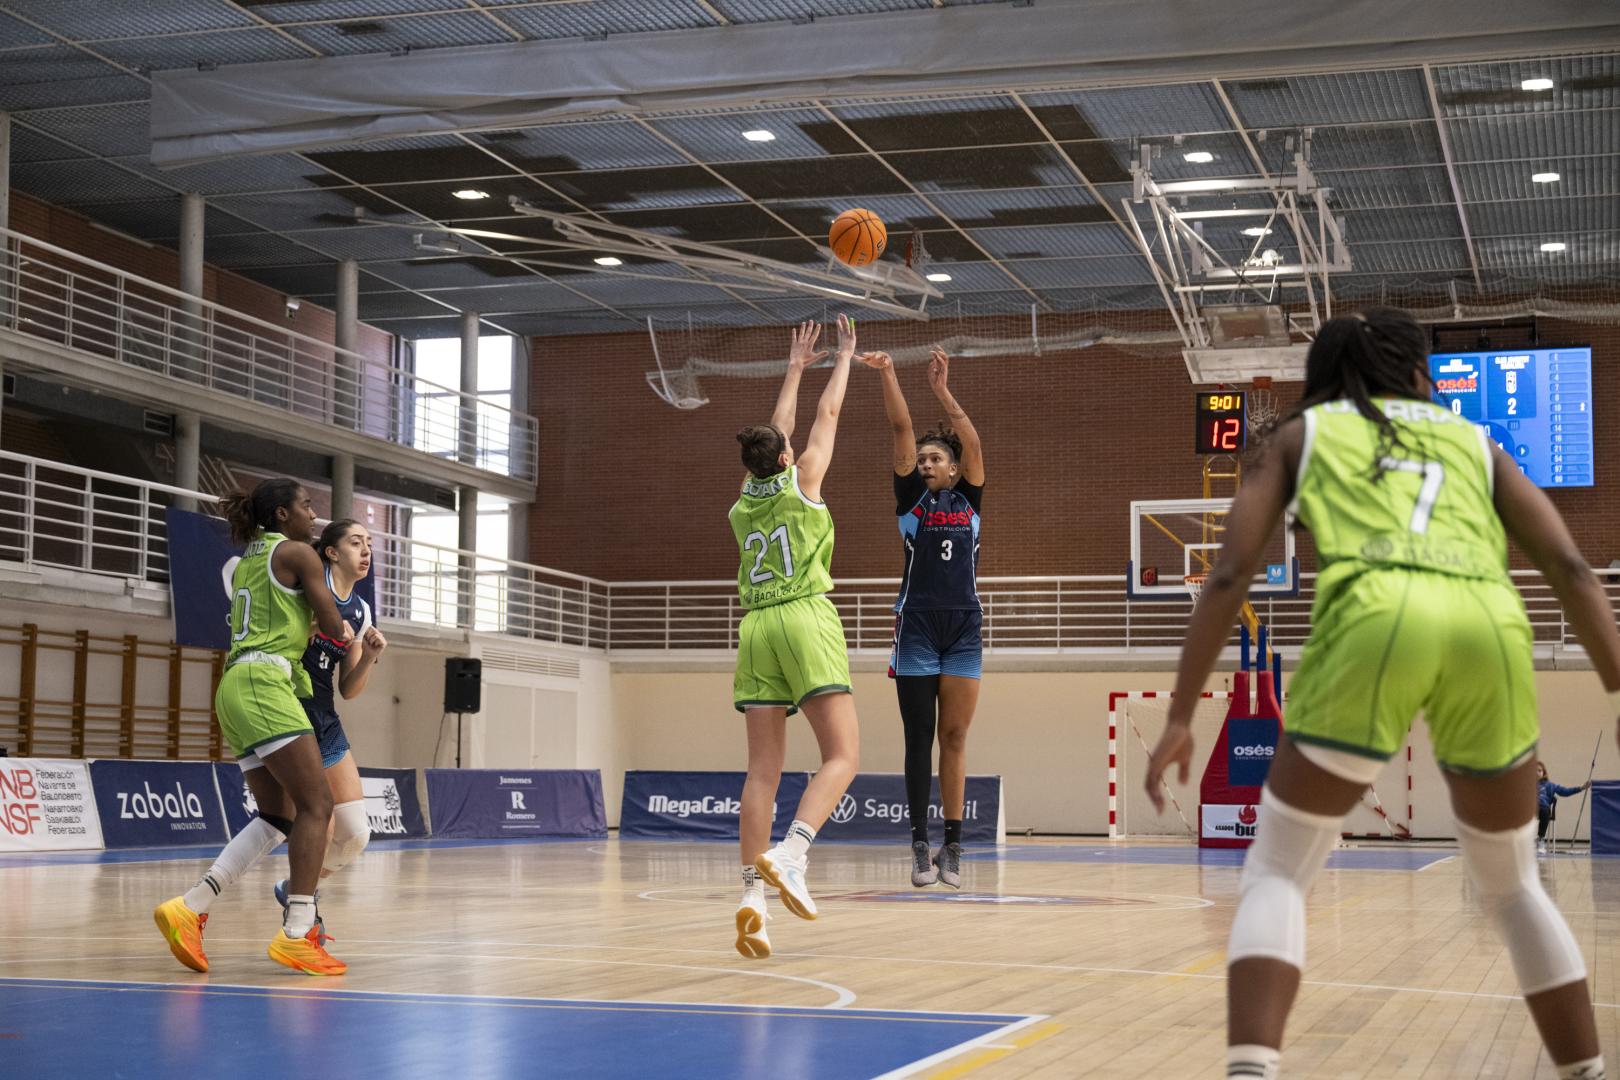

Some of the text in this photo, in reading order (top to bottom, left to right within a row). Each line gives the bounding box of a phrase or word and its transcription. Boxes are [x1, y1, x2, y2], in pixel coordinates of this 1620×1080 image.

[1210, 395, 1240, 410] 9:01
[1452, 398, 1461, 415] 0
[1507, 397, 1517, 415] 2
[1212, 418, 1240, 449] 12
[1378, 455, 1445, 535] 7
[744, 524, 794, 585] 21
[941, 539, 953, 561] 3
[319, 651, 330, 669] 5
[1234, 744, 1275, 756] osés
[499, 776, 533, 785] Jamones
[117, 781, 204, 819] zabala
[511, 791, 527, 810] R
[505, 811, 536, 820] Romero
[171, 822, 207, 831] INNOVATION
